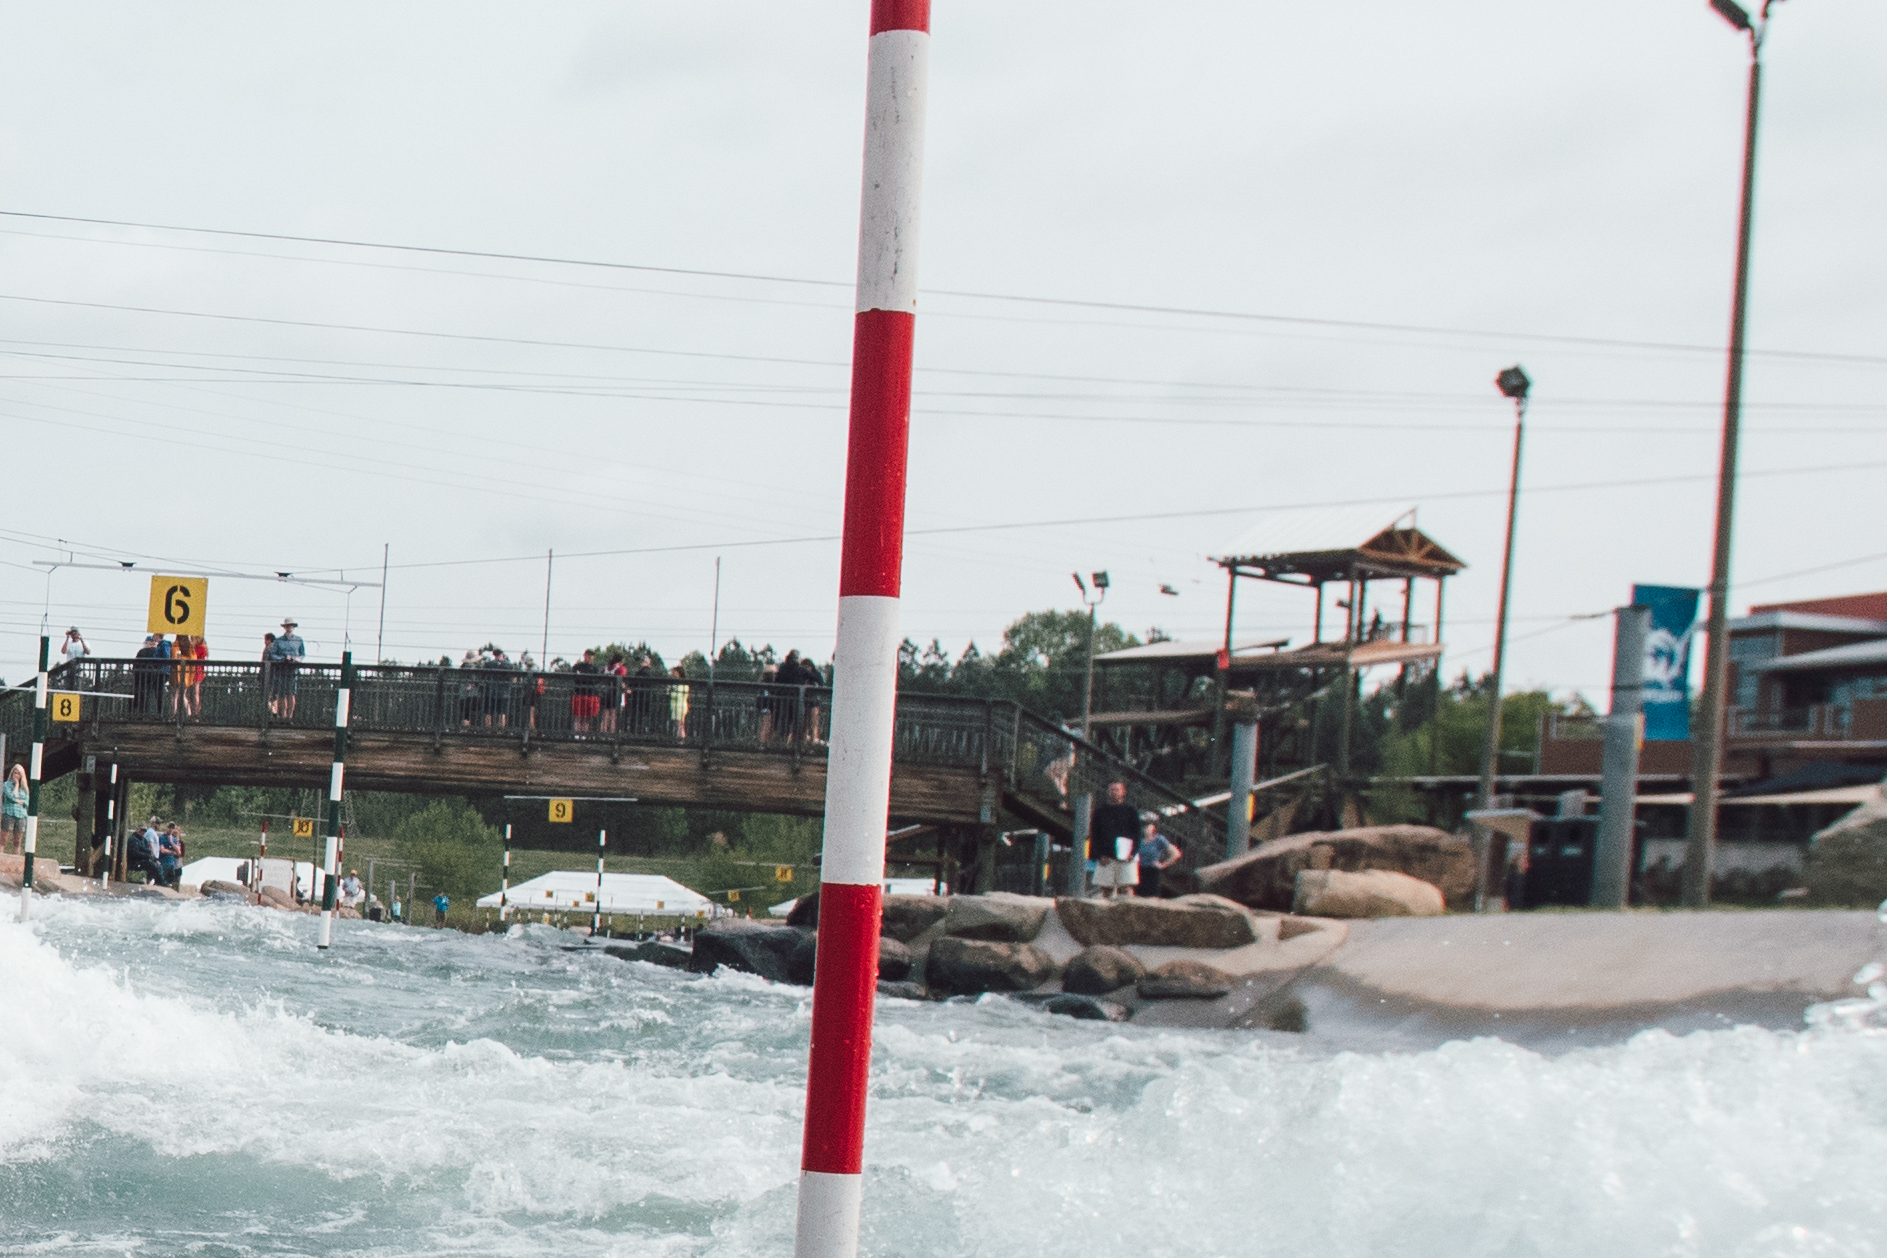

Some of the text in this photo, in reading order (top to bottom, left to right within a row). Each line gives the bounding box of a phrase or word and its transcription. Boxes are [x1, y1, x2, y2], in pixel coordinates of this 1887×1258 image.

[165, 585, 191, 625] 6
[60, 698, 72, 717] 8
[555, 802, 566, 818] 9
